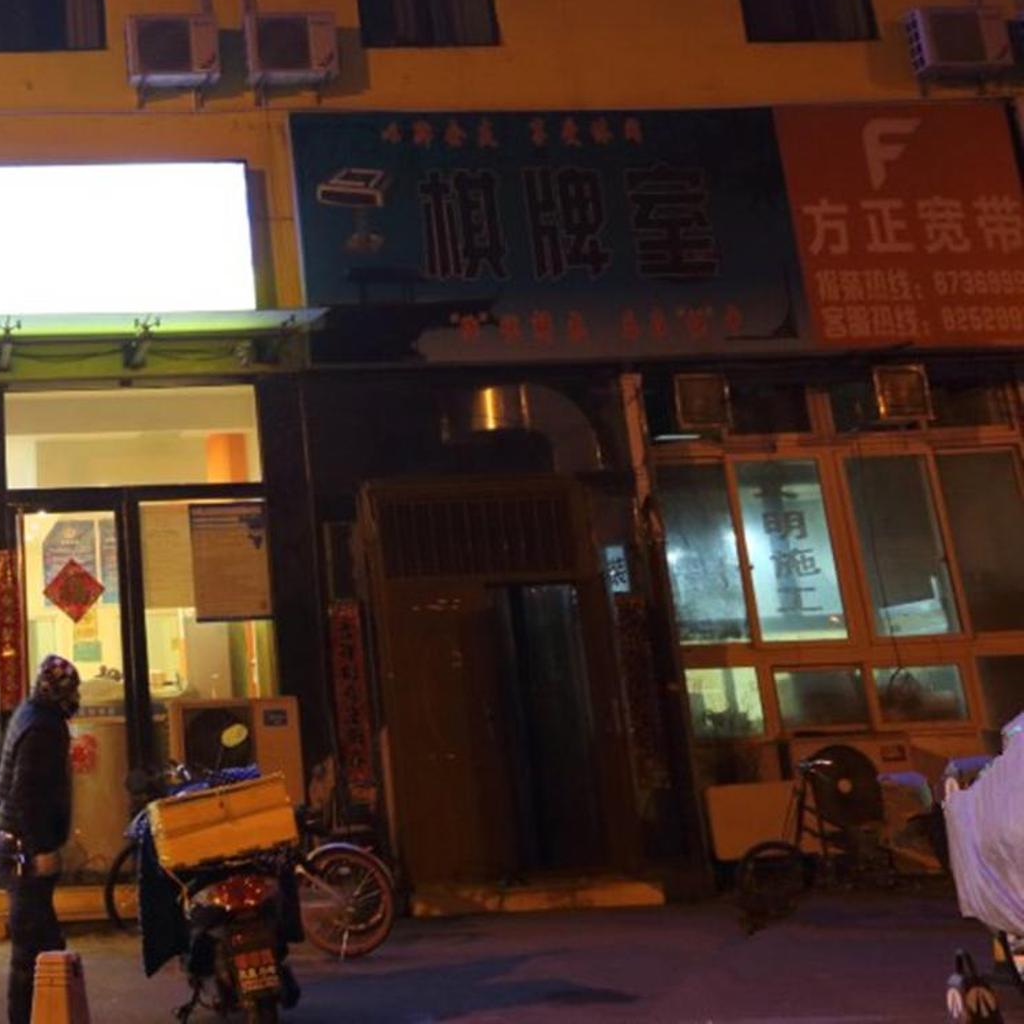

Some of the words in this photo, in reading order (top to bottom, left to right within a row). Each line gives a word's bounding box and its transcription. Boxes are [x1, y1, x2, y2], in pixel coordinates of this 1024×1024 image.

[417, 162, 722, 283] 棋牌室
[801, 195, 1024, 257] 方正宽带
